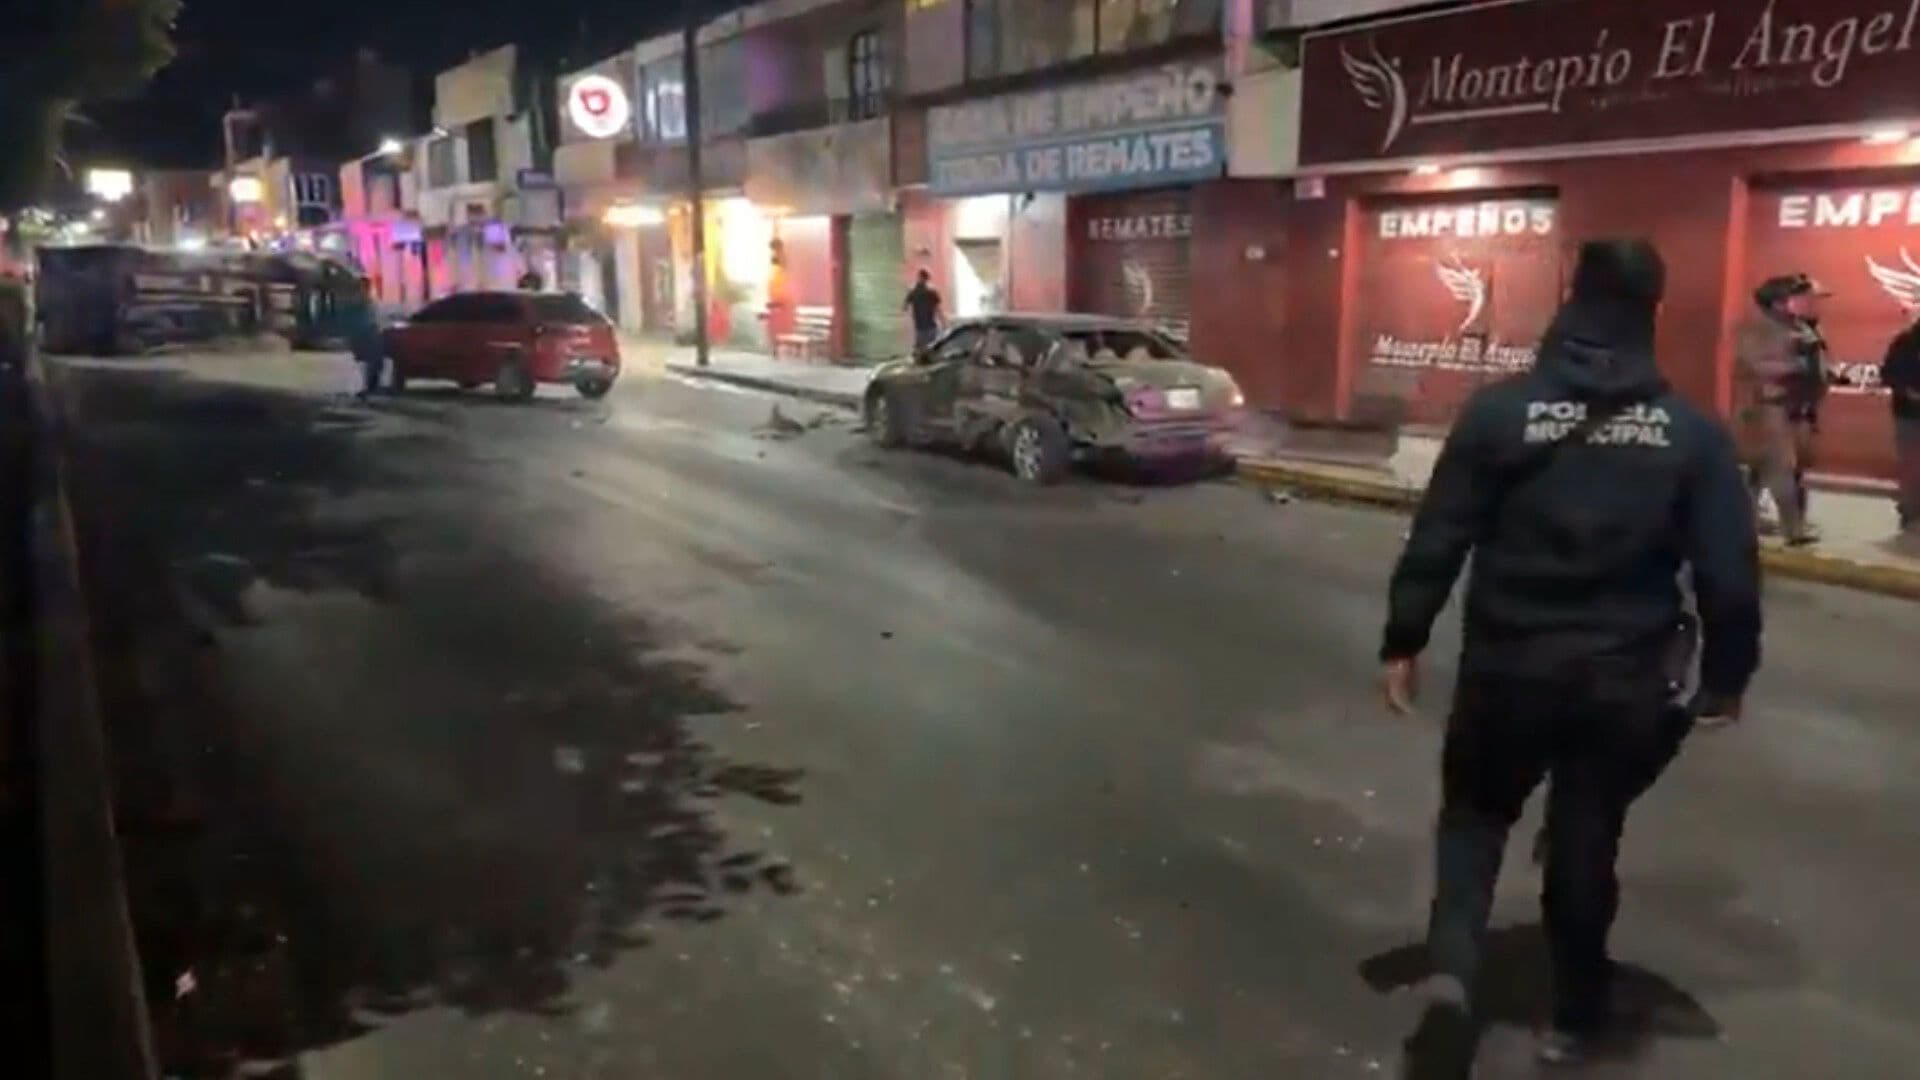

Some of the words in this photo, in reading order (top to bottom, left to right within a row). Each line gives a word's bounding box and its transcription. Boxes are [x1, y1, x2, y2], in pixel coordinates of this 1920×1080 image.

[1418, 29, 1632, 113] Montepío
[1652, 12, 1715, 79] El
[1025, 147, 1063, 182] DE
[1066, 129, 1213, 180] REMATES
